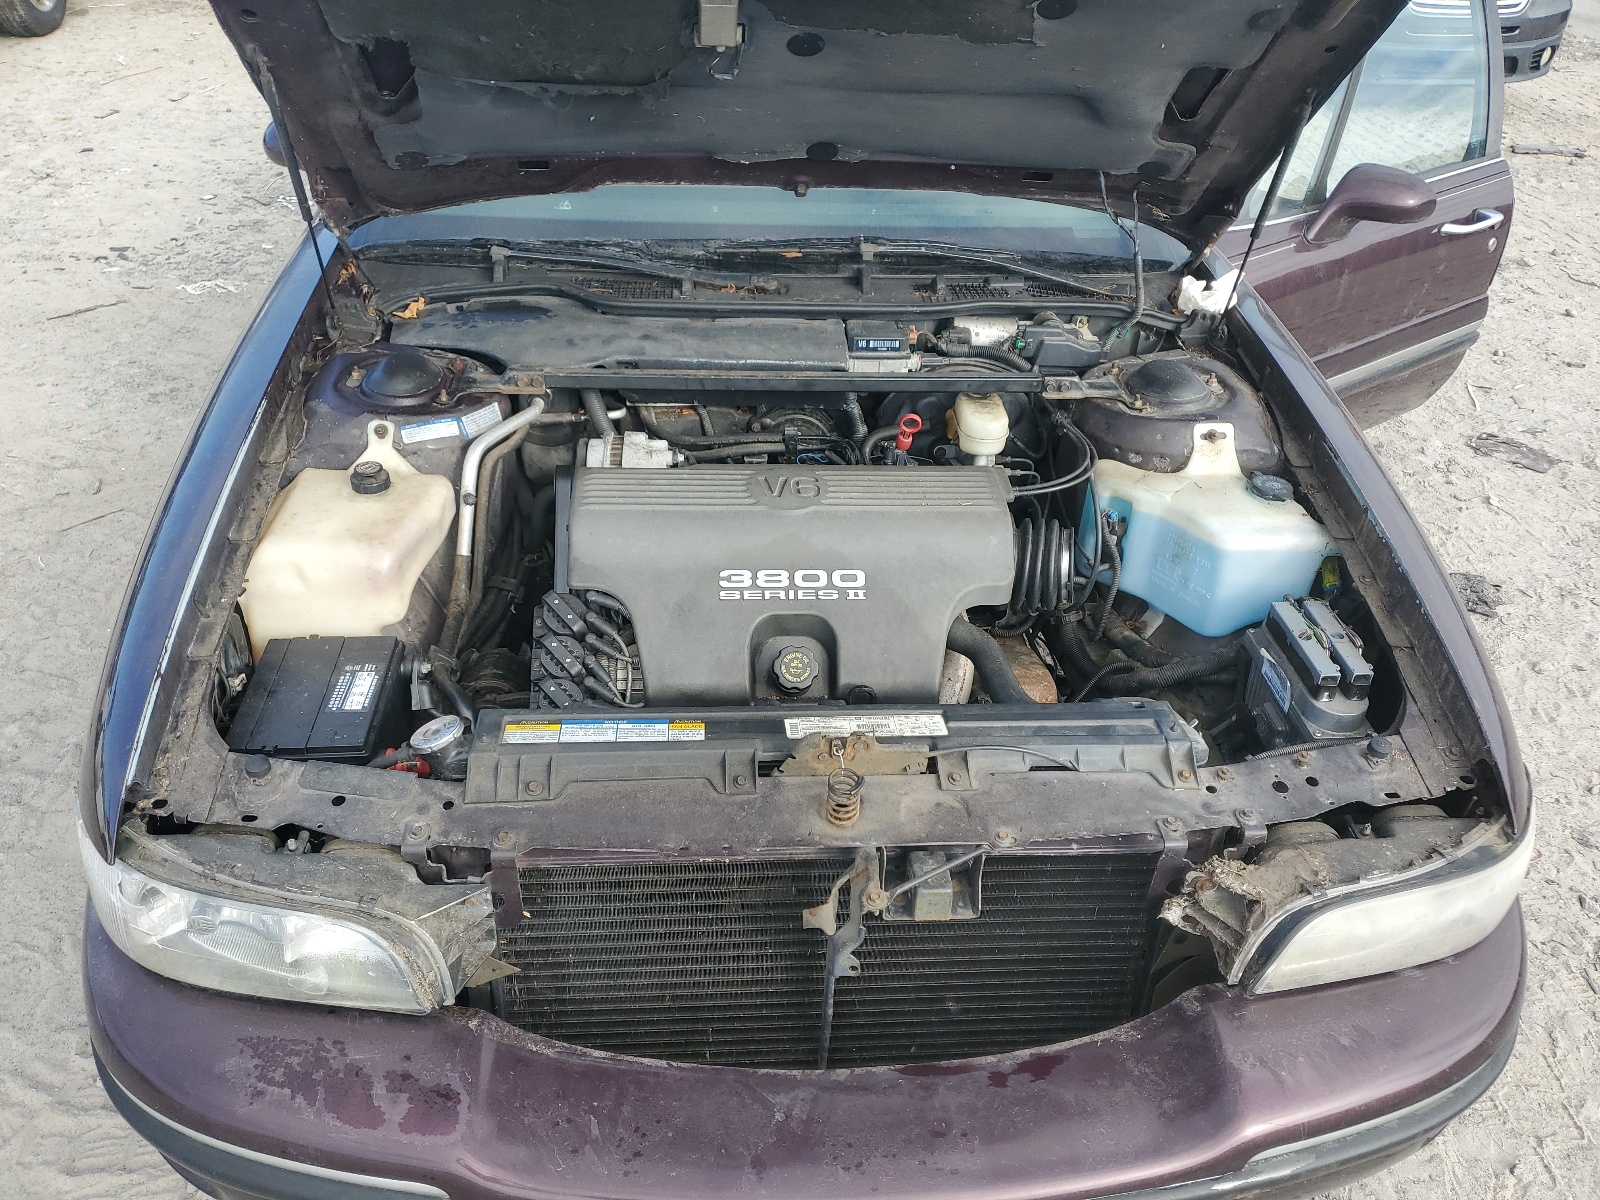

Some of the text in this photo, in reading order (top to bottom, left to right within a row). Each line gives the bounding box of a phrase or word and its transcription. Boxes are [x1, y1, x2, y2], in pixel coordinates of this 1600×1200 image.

[858, 340, 867, 348] V6
[757, 475, 821, 498] V6
[718, 568, 867, 588] 3800
[718, 589, 868, 600] SERIES II
